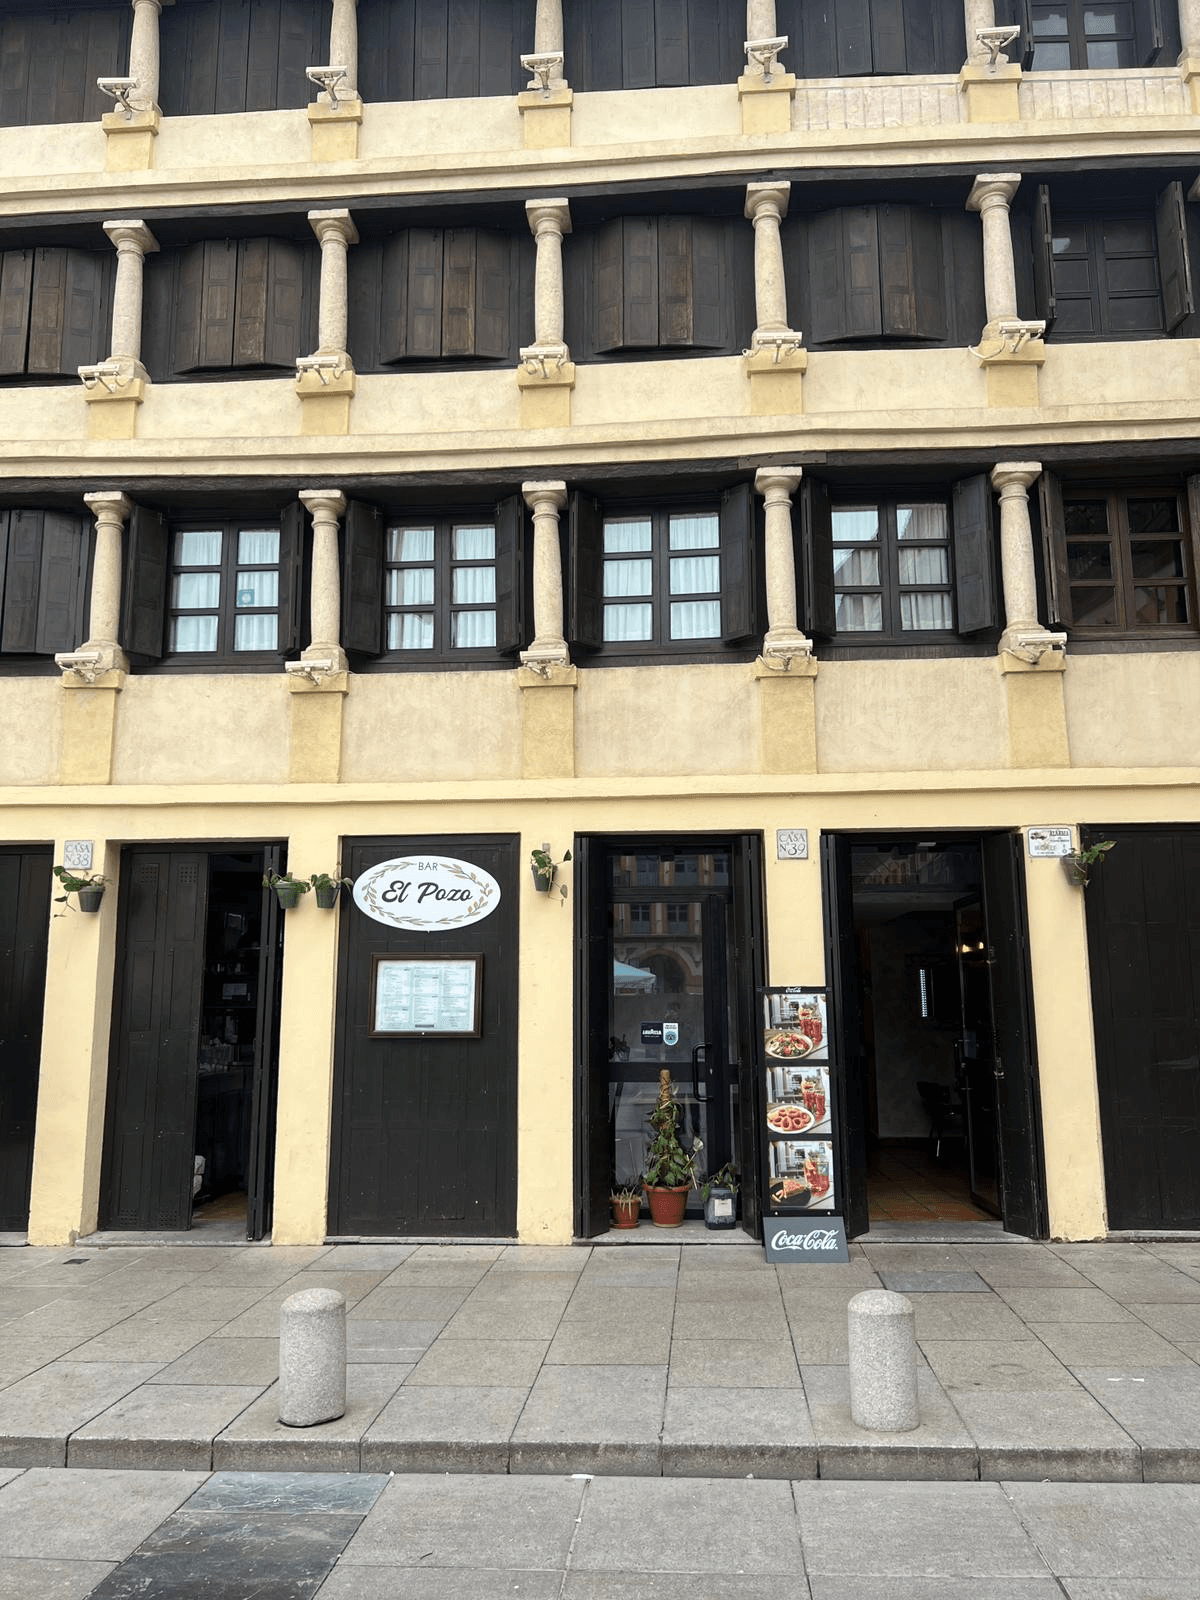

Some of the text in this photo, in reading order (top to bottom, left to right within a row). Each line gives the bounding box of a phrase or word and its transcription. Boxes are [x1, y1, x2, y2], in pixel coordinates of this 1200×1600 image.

[778, 833, 805, 842] CASA
[65, 844, 90, 853] CASA
[418, 862, 438, 871] BAR
[381, 880, 473, 904] El Pozo
[771, 1229, 840, 1251] Coca-Cola
